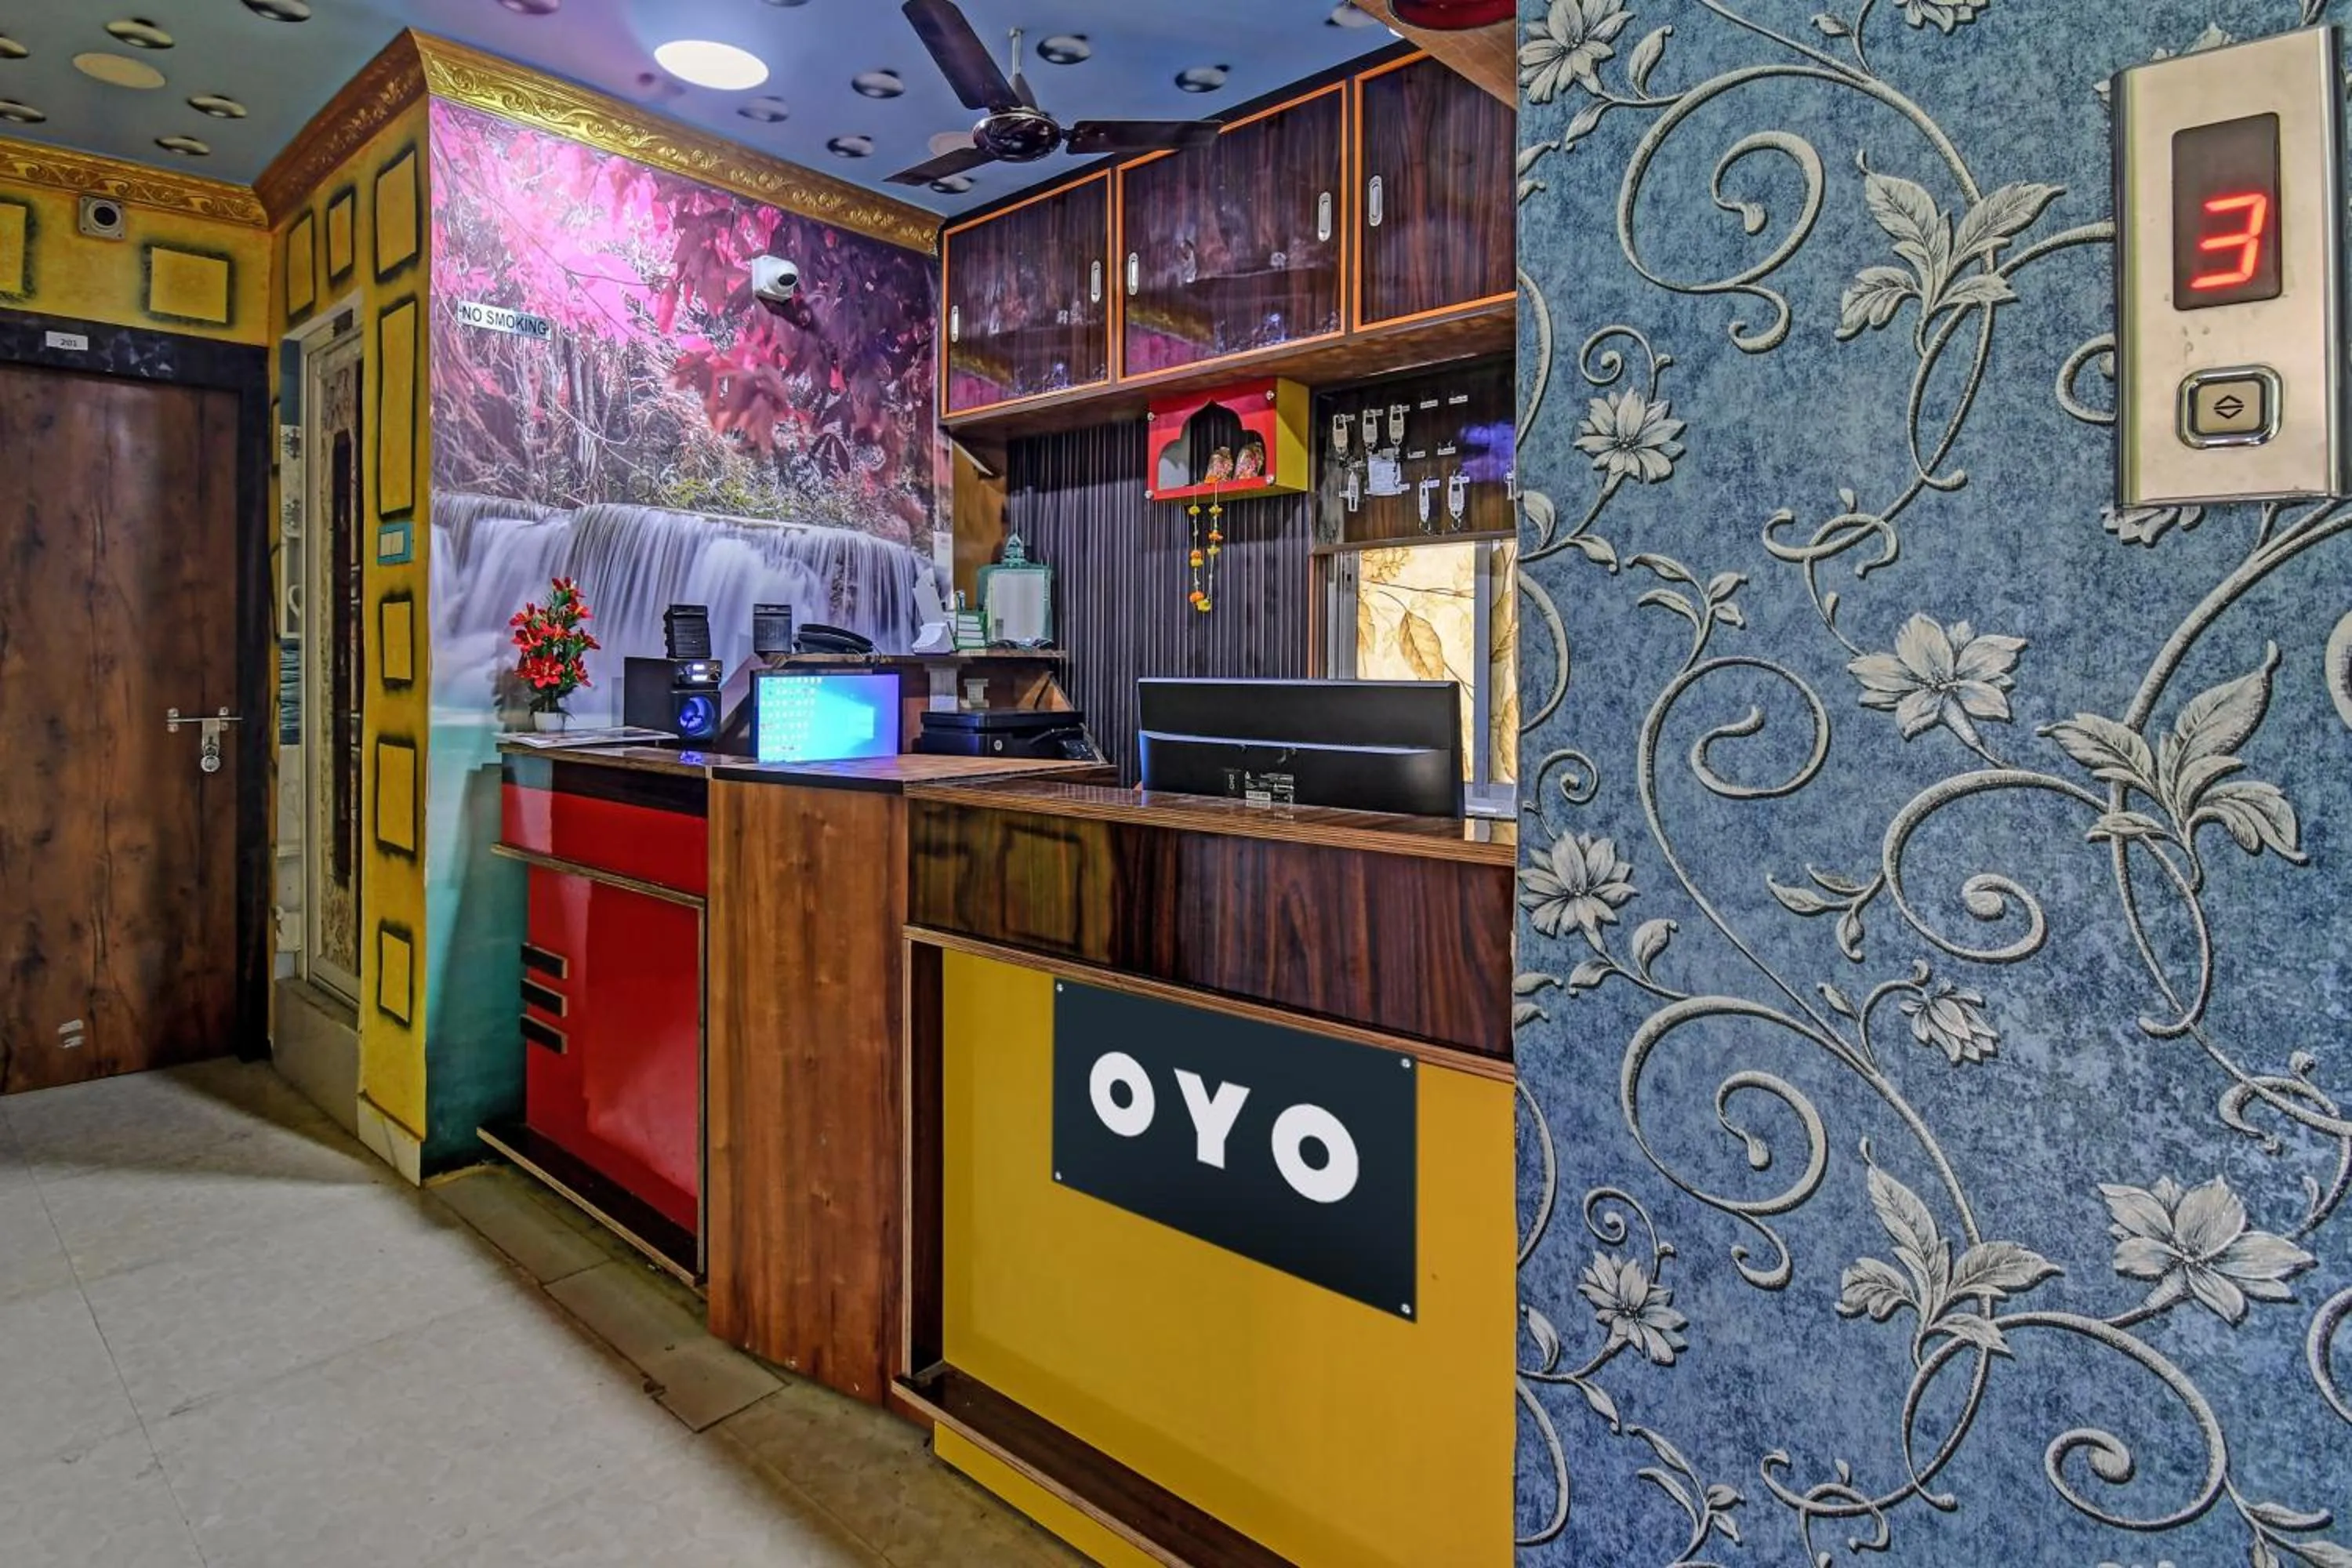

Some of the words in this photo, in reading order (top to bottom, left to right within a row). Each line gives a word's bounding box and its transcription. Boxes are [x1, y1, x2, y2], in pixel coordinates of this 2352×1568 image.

[2190, 193, 2267, 289] 3
[461, 305, 482, 322] NO
[486, 310, 547, 335] SMOKING
[1089, 1051, 1359, 1203] OYO
